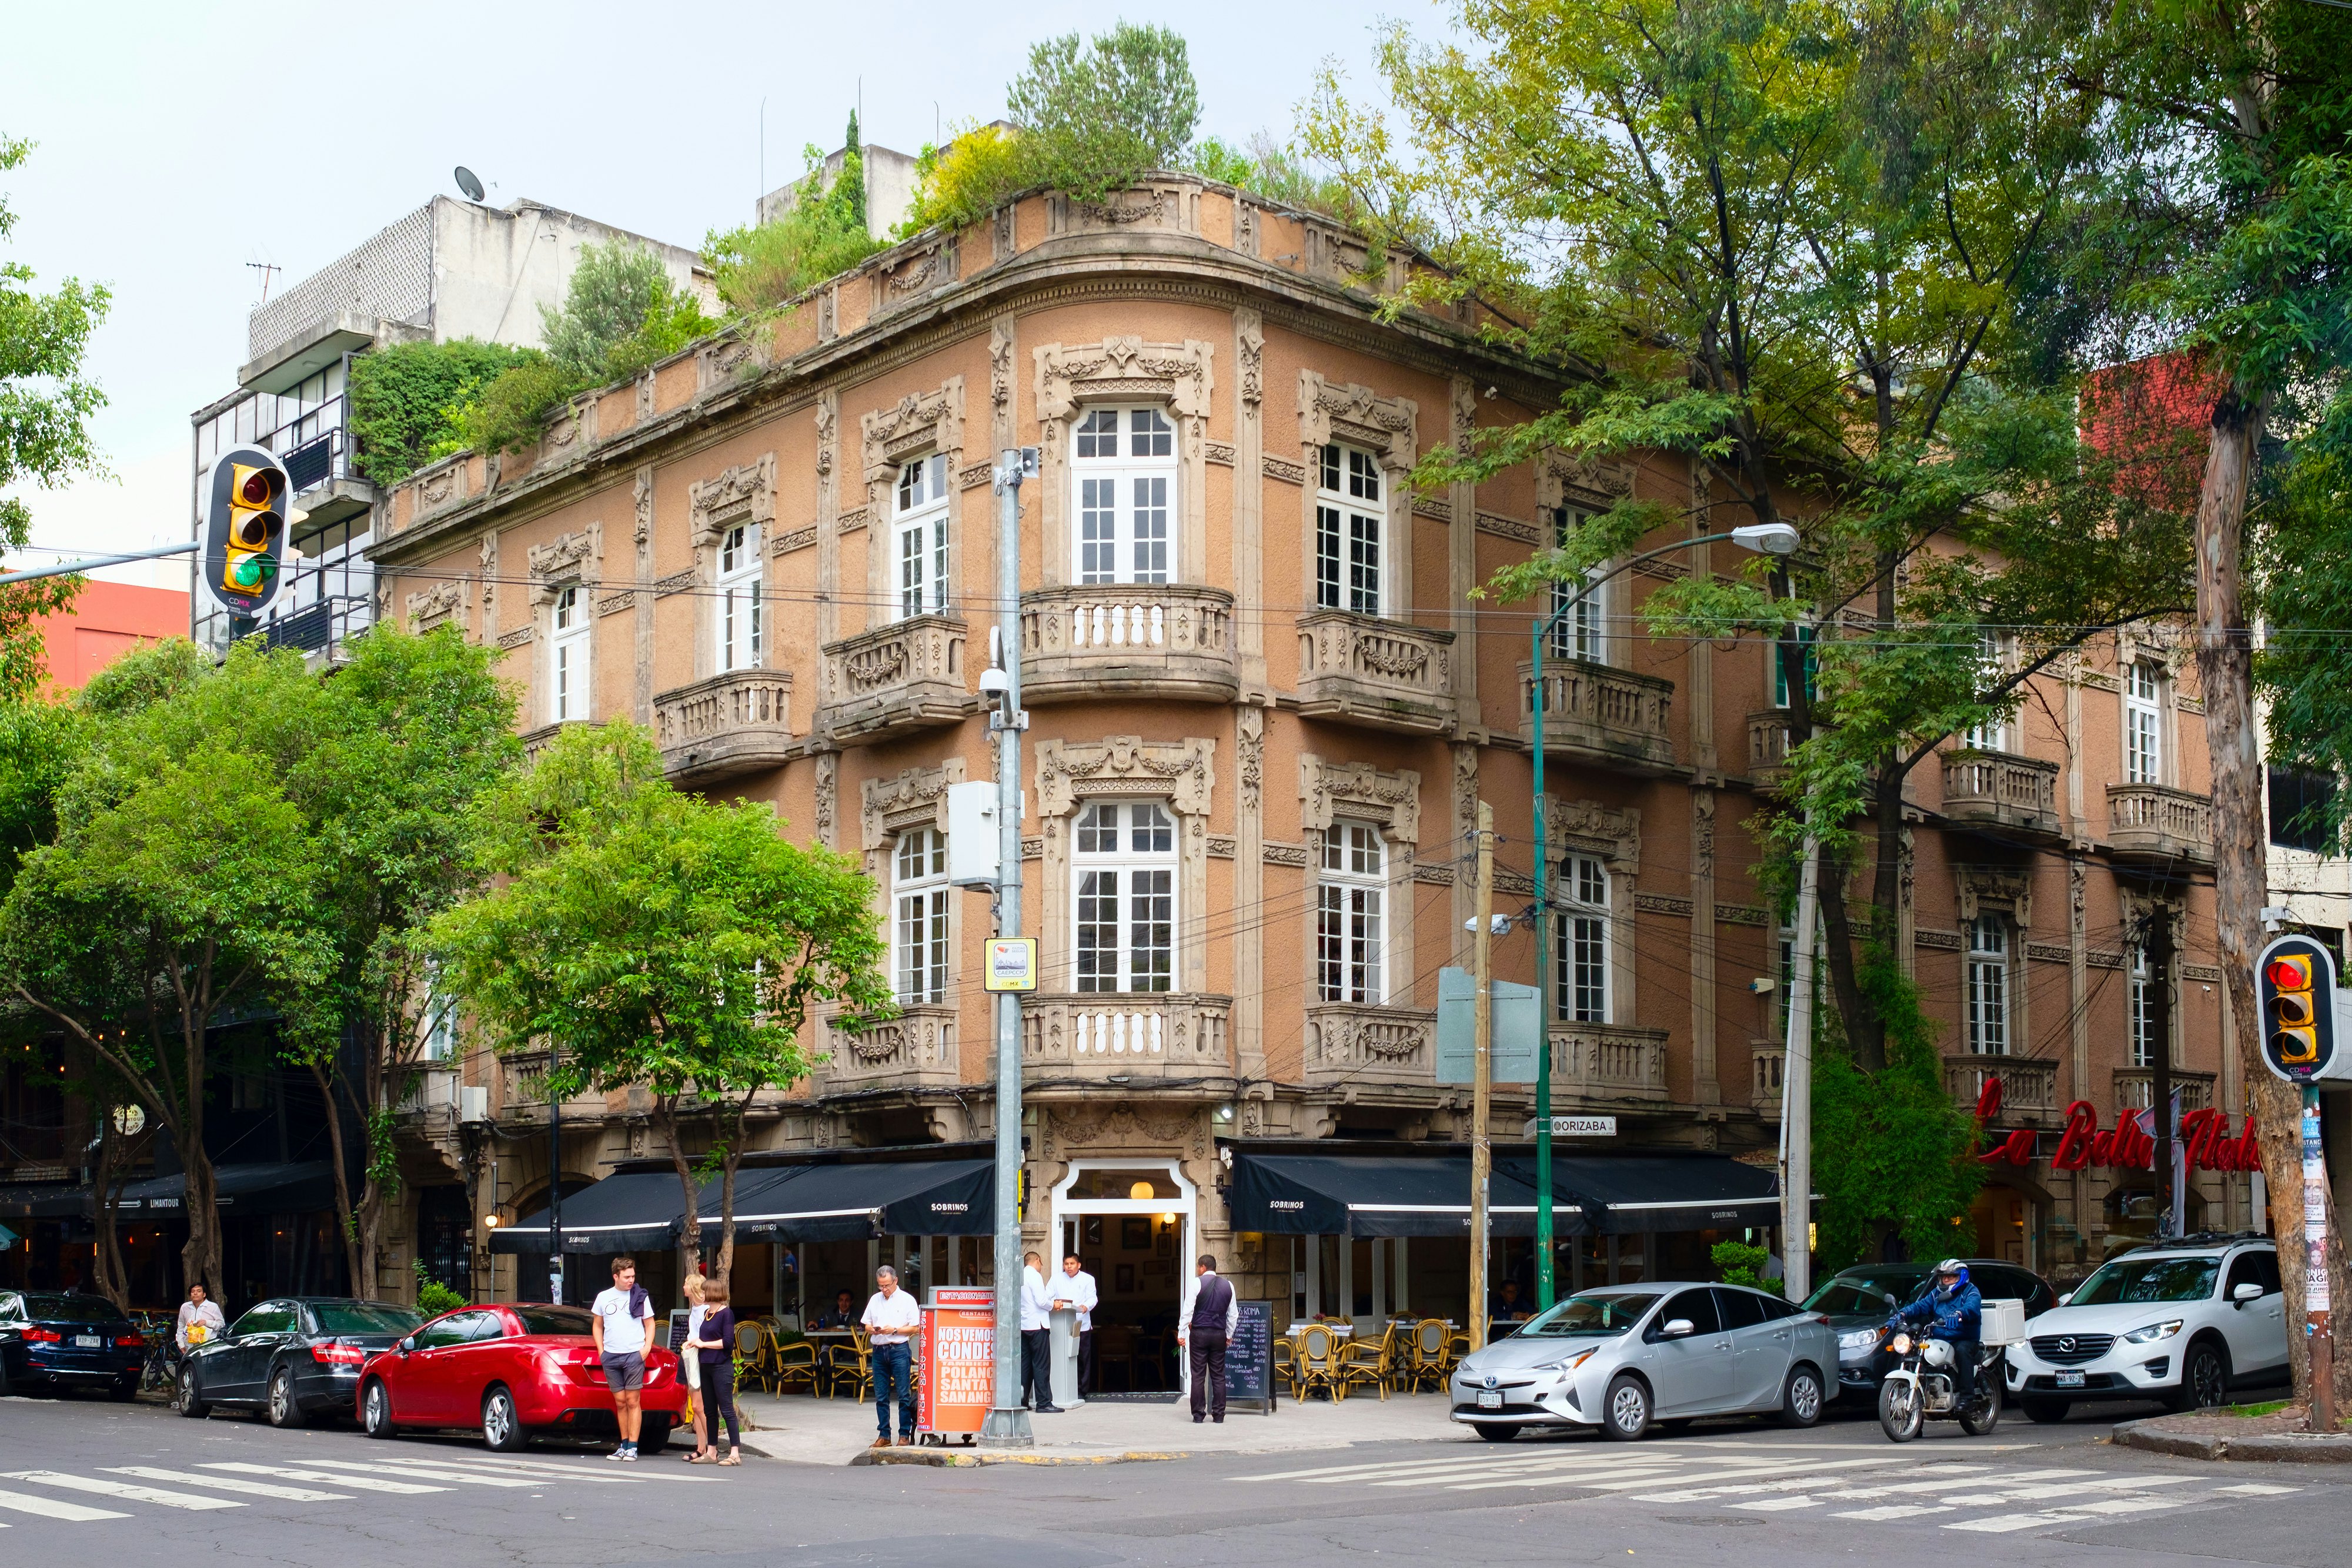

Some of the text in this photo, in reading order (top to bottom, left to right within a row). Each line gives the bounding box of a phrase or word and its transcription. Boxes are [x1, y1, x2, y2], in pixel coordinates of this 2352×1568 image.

[229, 597, 250, 607] CDMX
[1562, 1121, 1606, 1131] ORIZABA
[2051, 1100, 2154, 1171] Bella
[2181, 1108, 2263, 1182] Itali
[151, 1199, 179, 1208] LIMANTOUR
[931, 1203, 968, 1211] SOBRINOS
[1270, 1201, 1304, 1209] SOBRINOS
[751, 1223, 777, 1232] SOBRINOS
[940, 1292, 994, 1300] ESTACIONAMIE
[938, 1328, 961, 1341] NOS
[941, 1379, 988, 1391] SANTA
[940, 1390, 993, 1403] SAN ANG
